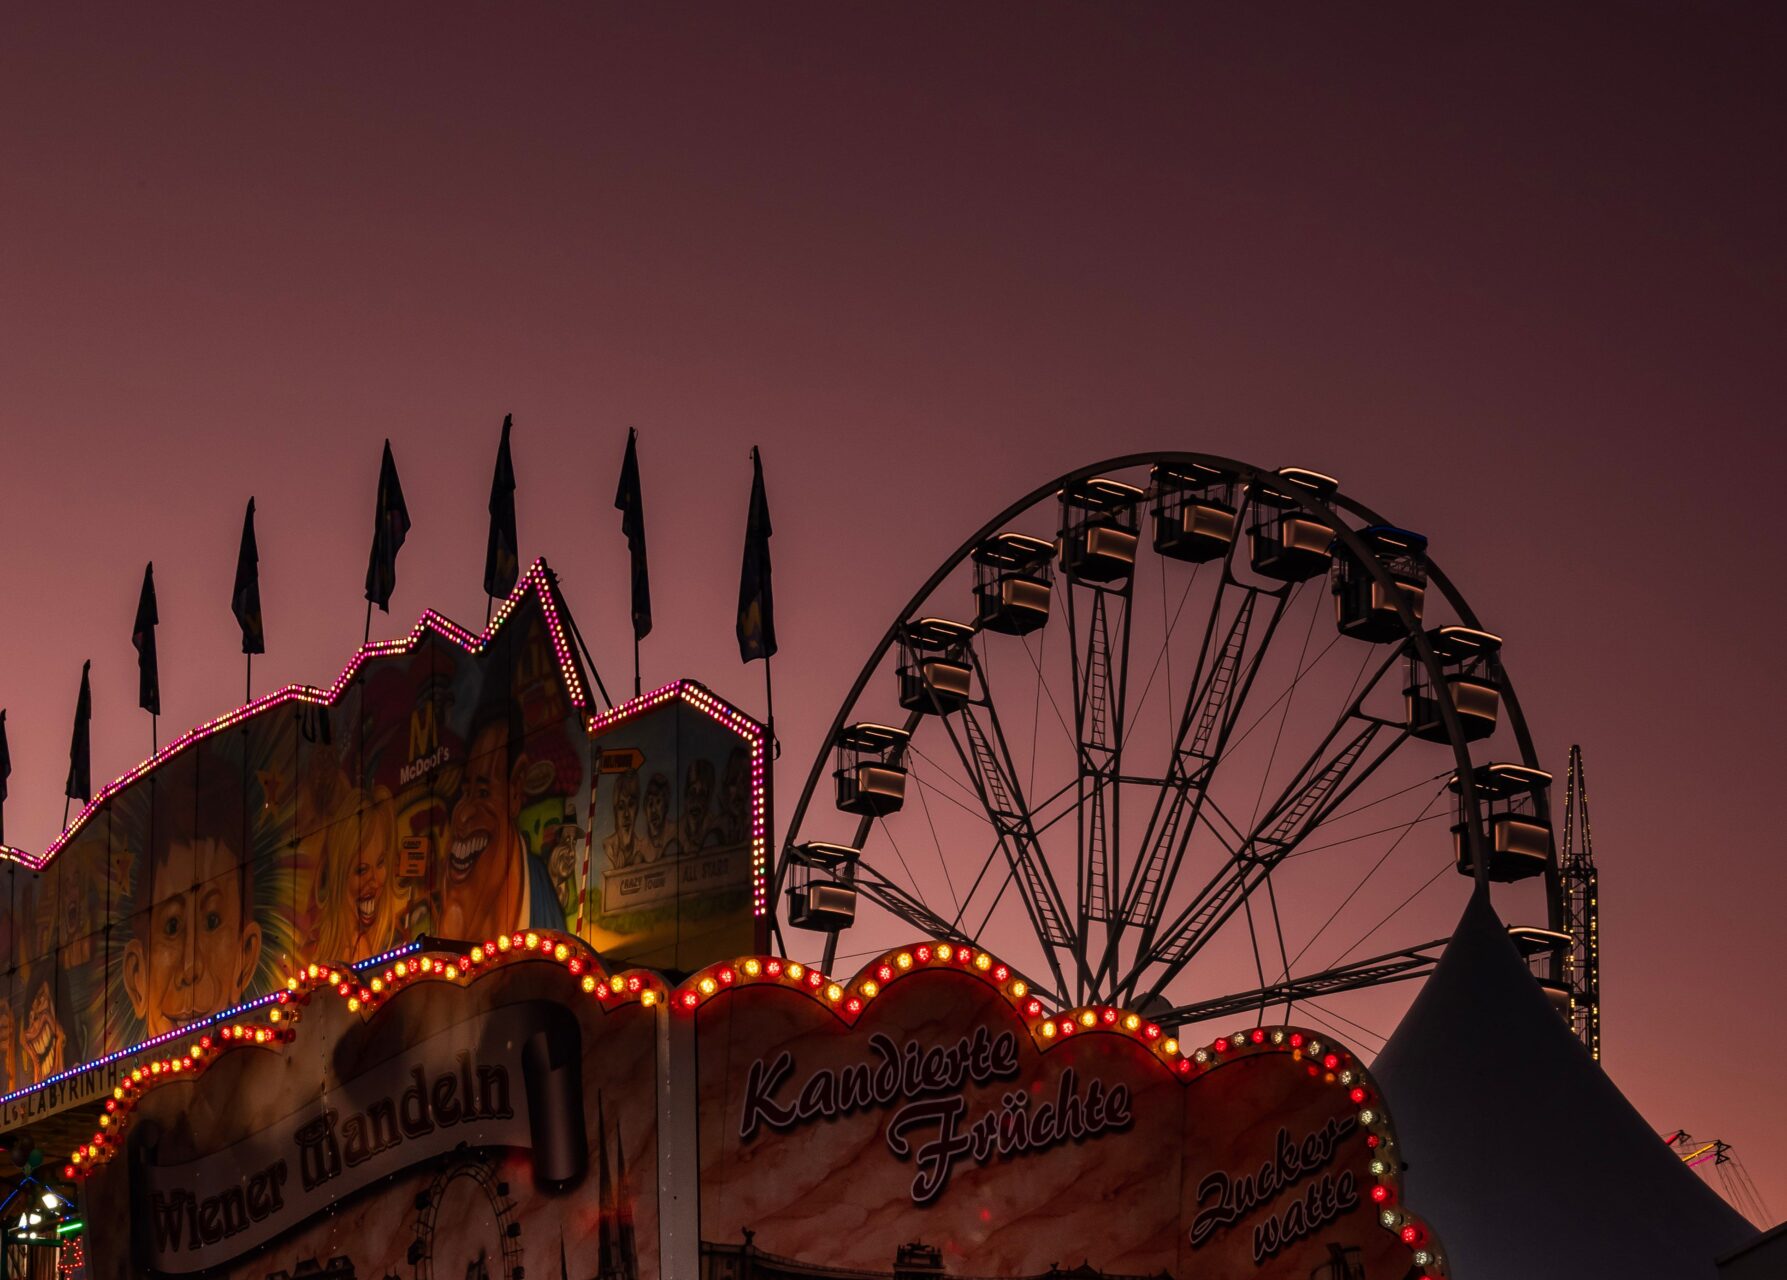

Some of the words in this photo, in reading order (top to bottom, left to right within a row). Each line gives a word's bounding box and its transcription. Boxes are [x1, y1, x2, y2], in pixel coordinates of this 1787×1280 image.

[683, 863, 698, 882] ALL
[28, 1061, 118, 1117] LABYRINTH
[740, 1025, 1018, 1137] Kandierte
[886, 1067, 1132, 1201] Früchte
[146, 1157, 288, 1254] Wiener
[295, 1049, 513, 1192] Mandeln
[1190, 1115, 1357, 1244] Zucker-
[1253, 1169, 1358, 1261] watte
